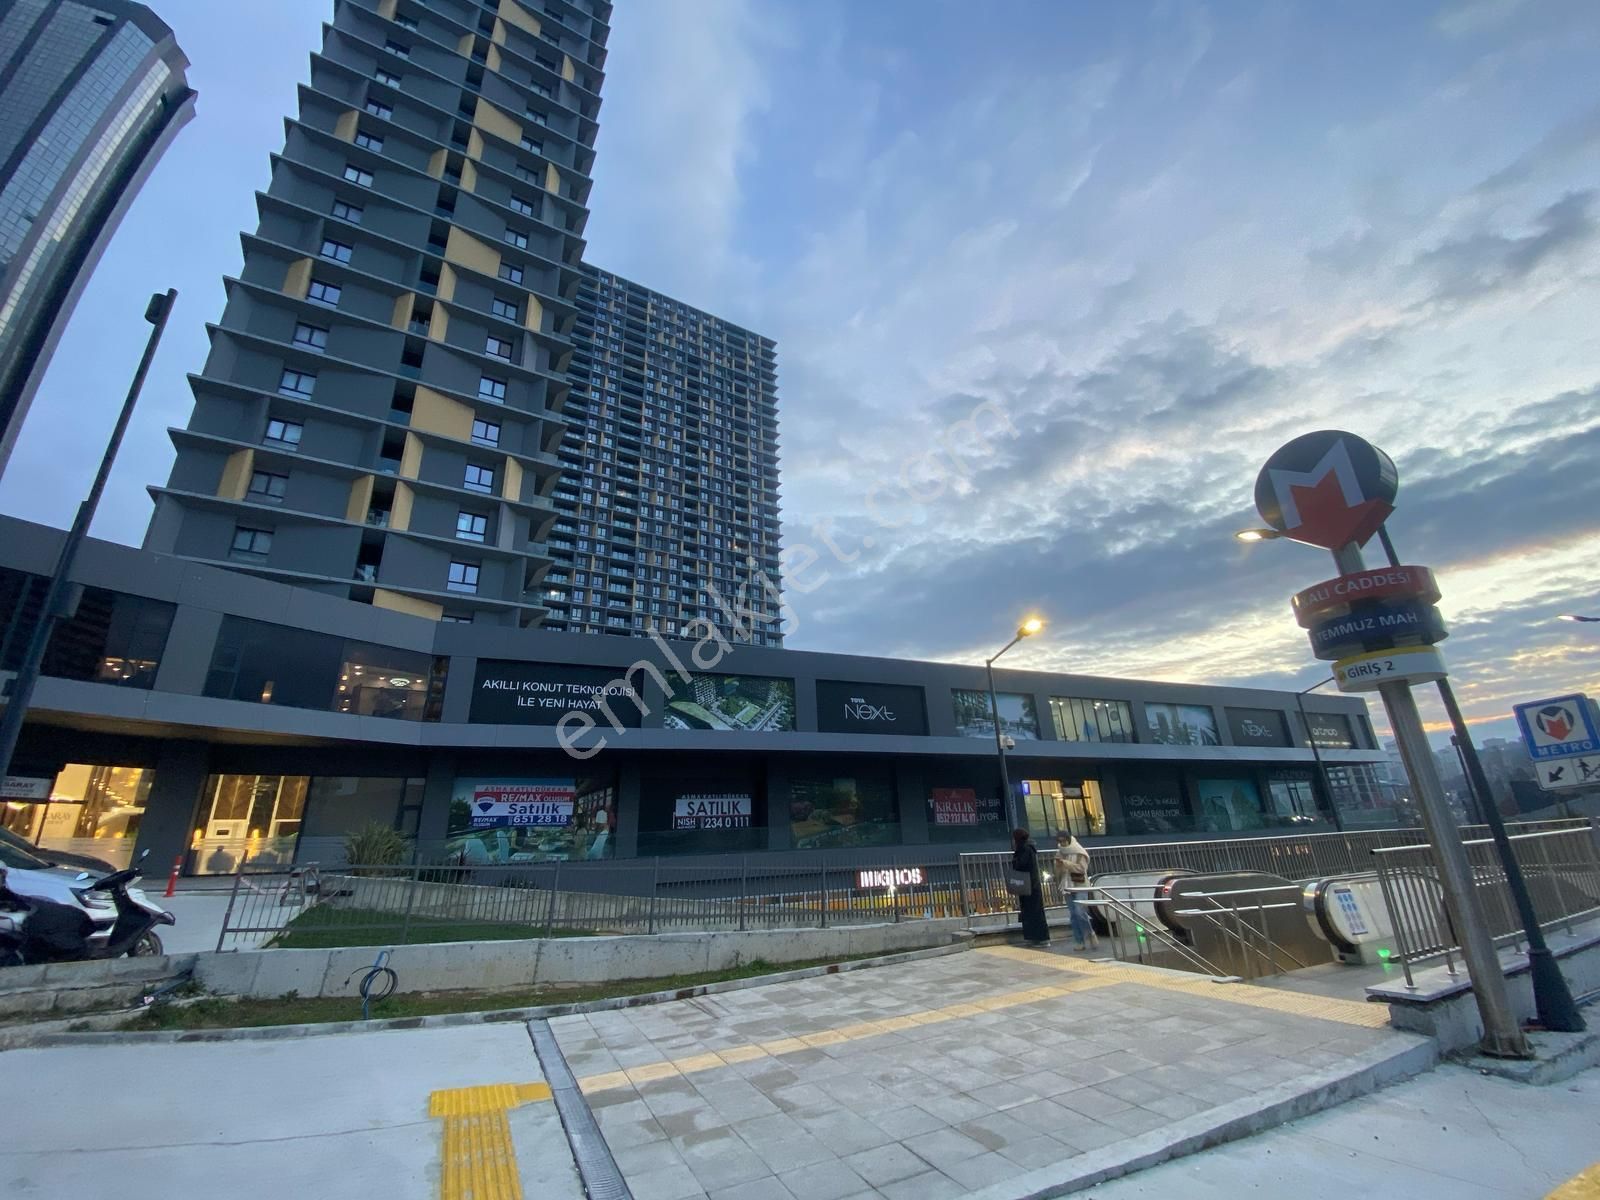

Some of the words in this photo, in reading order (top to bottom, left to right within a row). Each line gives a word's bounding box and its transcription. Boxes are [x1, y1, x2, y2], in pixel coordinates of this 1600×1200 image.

[1347, 662, 1381, 679] GİRİŞ
[1384, 660, 1395, 671] 2
[482, 680, 520, 691] AKILLI
[522, 681, 563, 693] KONUT
[566, 684, 635, 697] TEKNOLOJİSİ
[517, 695, 535, 707] İLE
[538, 697, 565, 708] YENİ
[568, 700, 603, 710] HAYAT
[1537, 740, 1593, 757] METRO
[500, 793, 542, 802] RE/MAX
[508, 803, 560, 815] Satılık
[687, 800, 741, 815] SATILIK
[513, 815, 533, 823] 651
[537, 815, 552, 823] 28
[556, 815, 567, 823] 18
[705, 817, 723, 829] 234
[735, 816, 749, 827] 111
